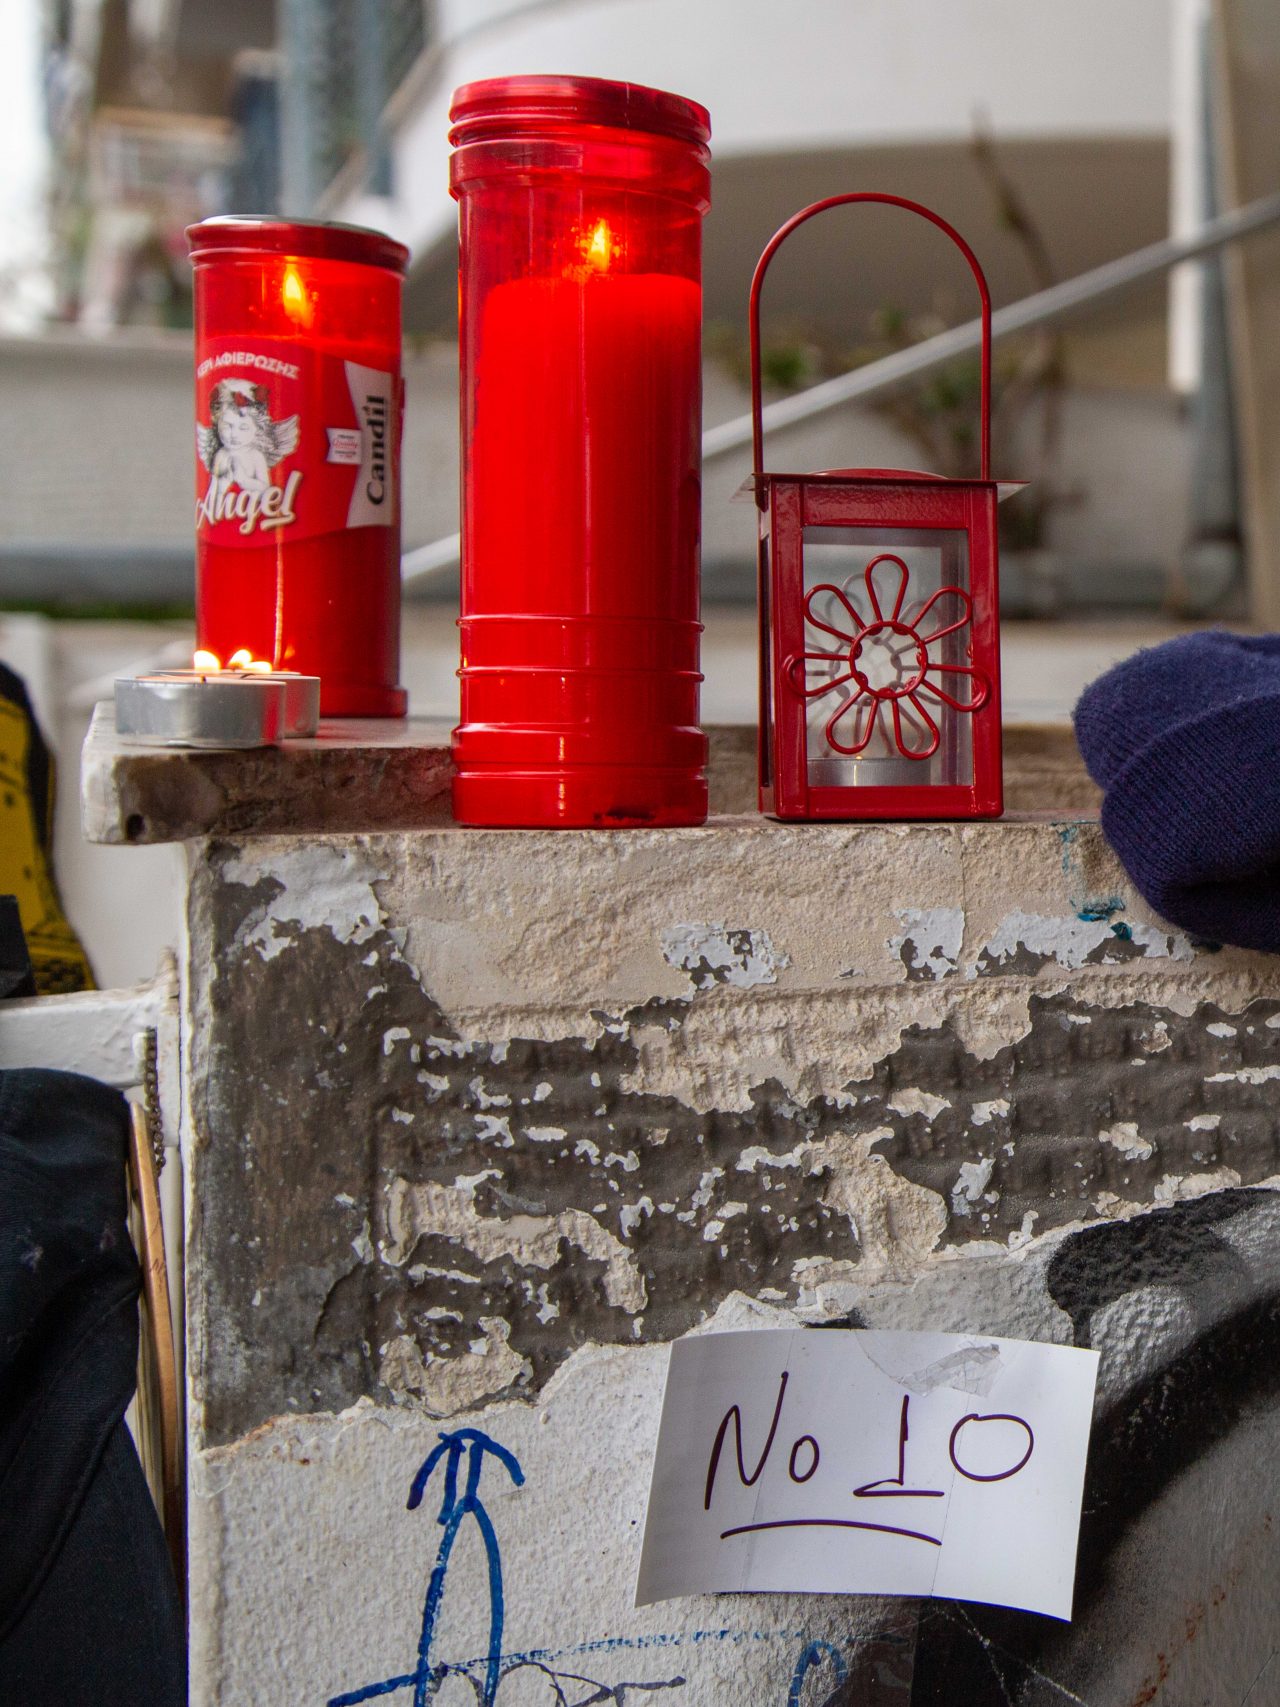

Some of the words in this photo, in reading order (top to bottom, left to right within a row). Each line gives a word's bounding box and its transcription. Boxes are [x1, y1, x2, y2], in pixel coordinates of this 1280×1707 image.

[214, 351, 299, 380] ΑΦΙΕΡΩΣΗΣ
[363, 395, 384, 505] Candil
[197, 470, 303, 535] Angel
[704, 1370, 821, 1511] No
[852, 1394, 1035, 1498] 10
